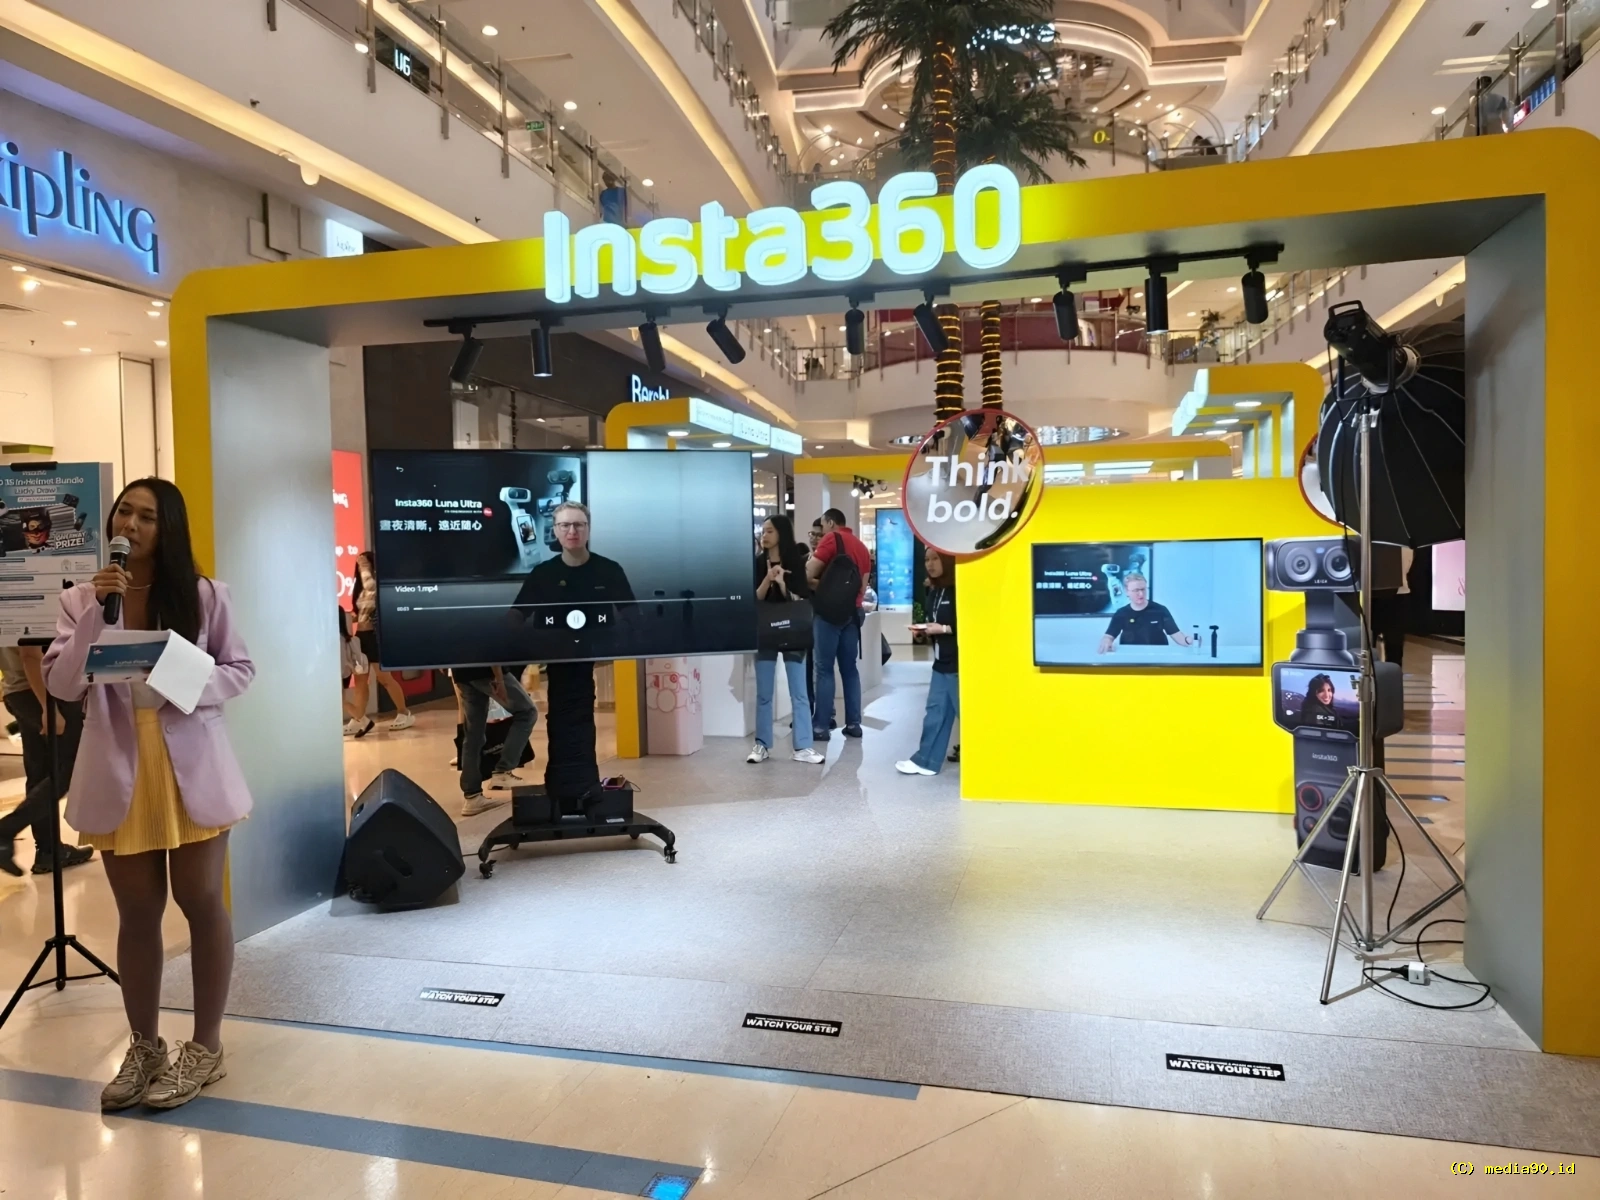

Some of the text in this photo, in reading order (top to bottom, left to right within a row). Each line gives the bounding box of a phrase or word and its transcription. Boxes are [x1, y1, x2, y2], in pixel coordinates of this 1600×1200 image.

[543, 163, 1021, 303] Insta360
[925, 452, 1029, 487] Think
[395, 499, 482, 508] Insta360 Luna Ultra
[926, 491, 1018, 523] bold.
[55, 538, 84, 549] PRIZE!
[395, 585, 416, 593] Video
[420, 991, 454, 1001] WATCH
[454, 994, 478, 1003] YOUR
[477, 996, 500, 1005] STEP
[746, 1018, 784, 1028] WATCH
[785, 1022, 813, 1031] YOUR
[813, 1025, 838, 1034] STEP
[1169, 1060, 1215, 1071] WATCH
[1216, 1064, 1250, 1075] YOUR
[1252, 1068, 1281, 1078] STEP
